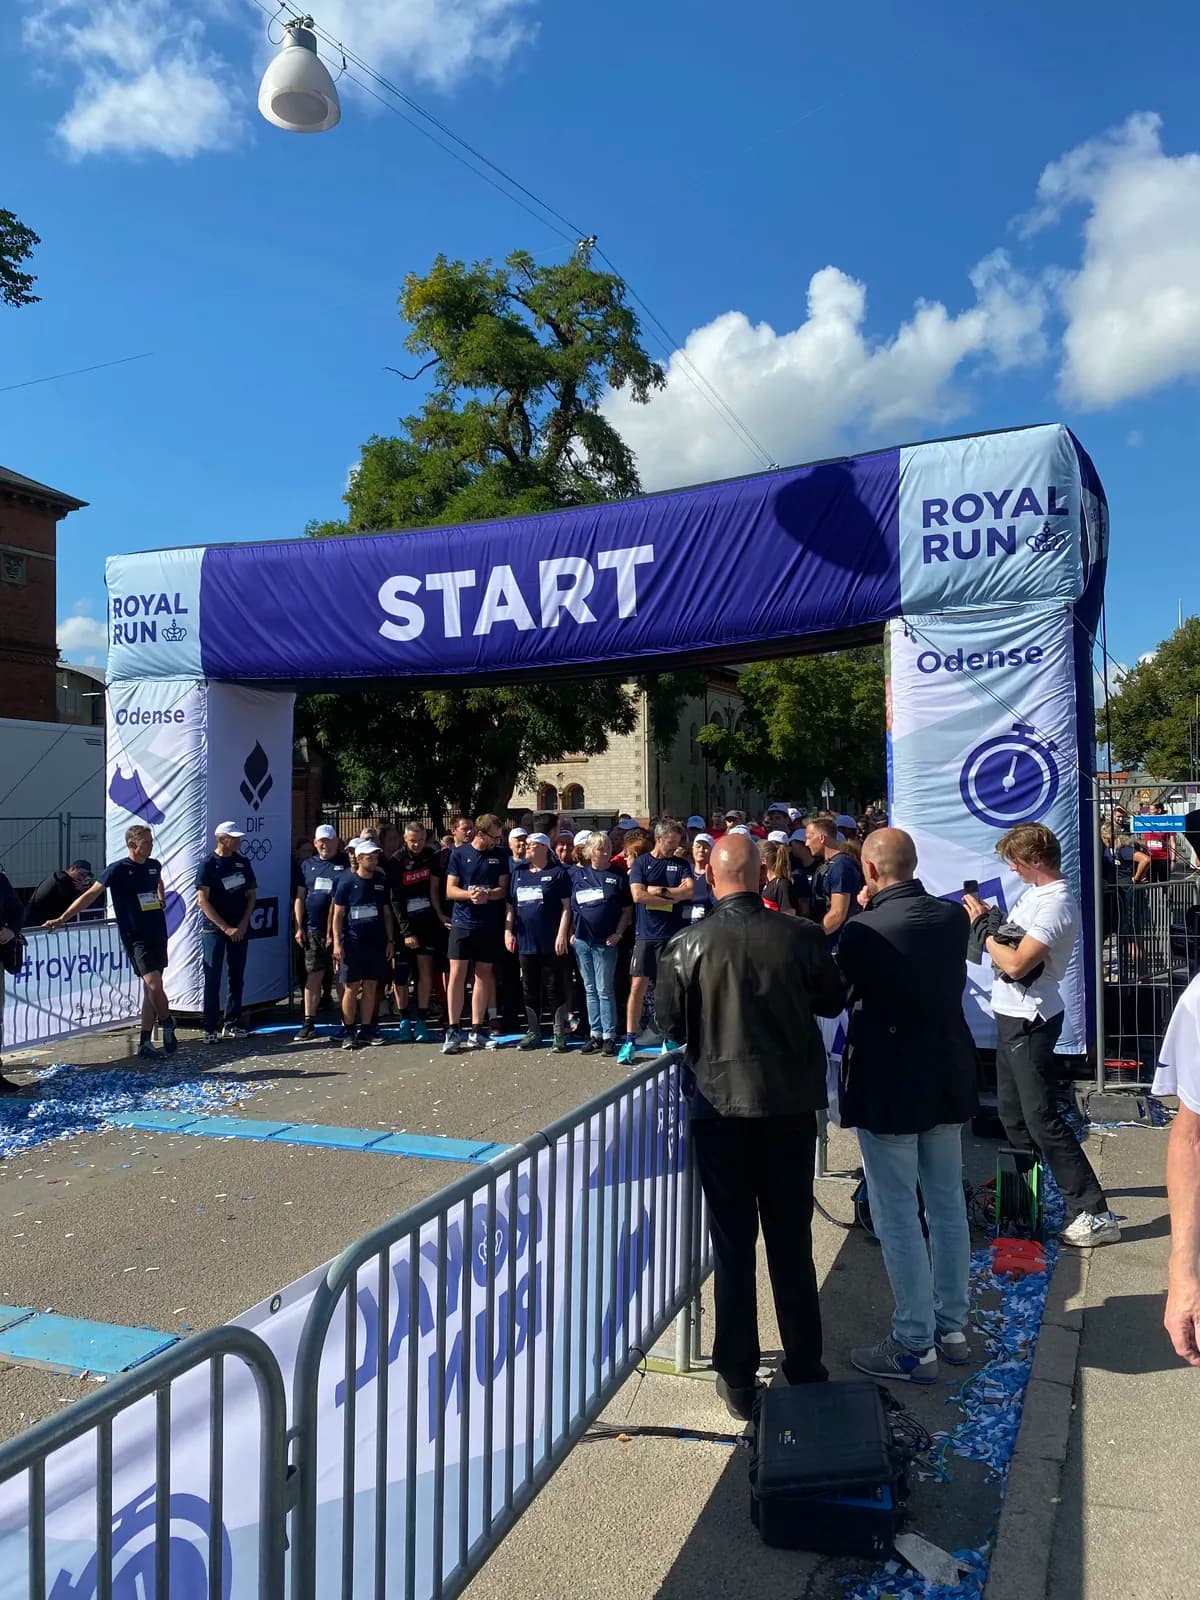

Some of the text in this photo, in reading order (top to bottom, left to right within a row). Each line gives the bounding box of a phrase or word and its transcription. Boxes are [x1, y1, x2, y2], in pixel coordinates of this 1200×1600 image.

[922, 486, 1069, 528] ROYAL
[923, 525, 1017, 564] RUN
[113, 592, 188, 620] ROYAL
[378, 544, 654, 642] START
[113, 621, 157, 645] RUN
[917, 645, 1044, 674] Odense
[115, 707, 185, 726] Odense
[246, 817, 265, 833] DIF
[250, 907, 275, 931] GI
[15, 946, 130, 984] #royalru
